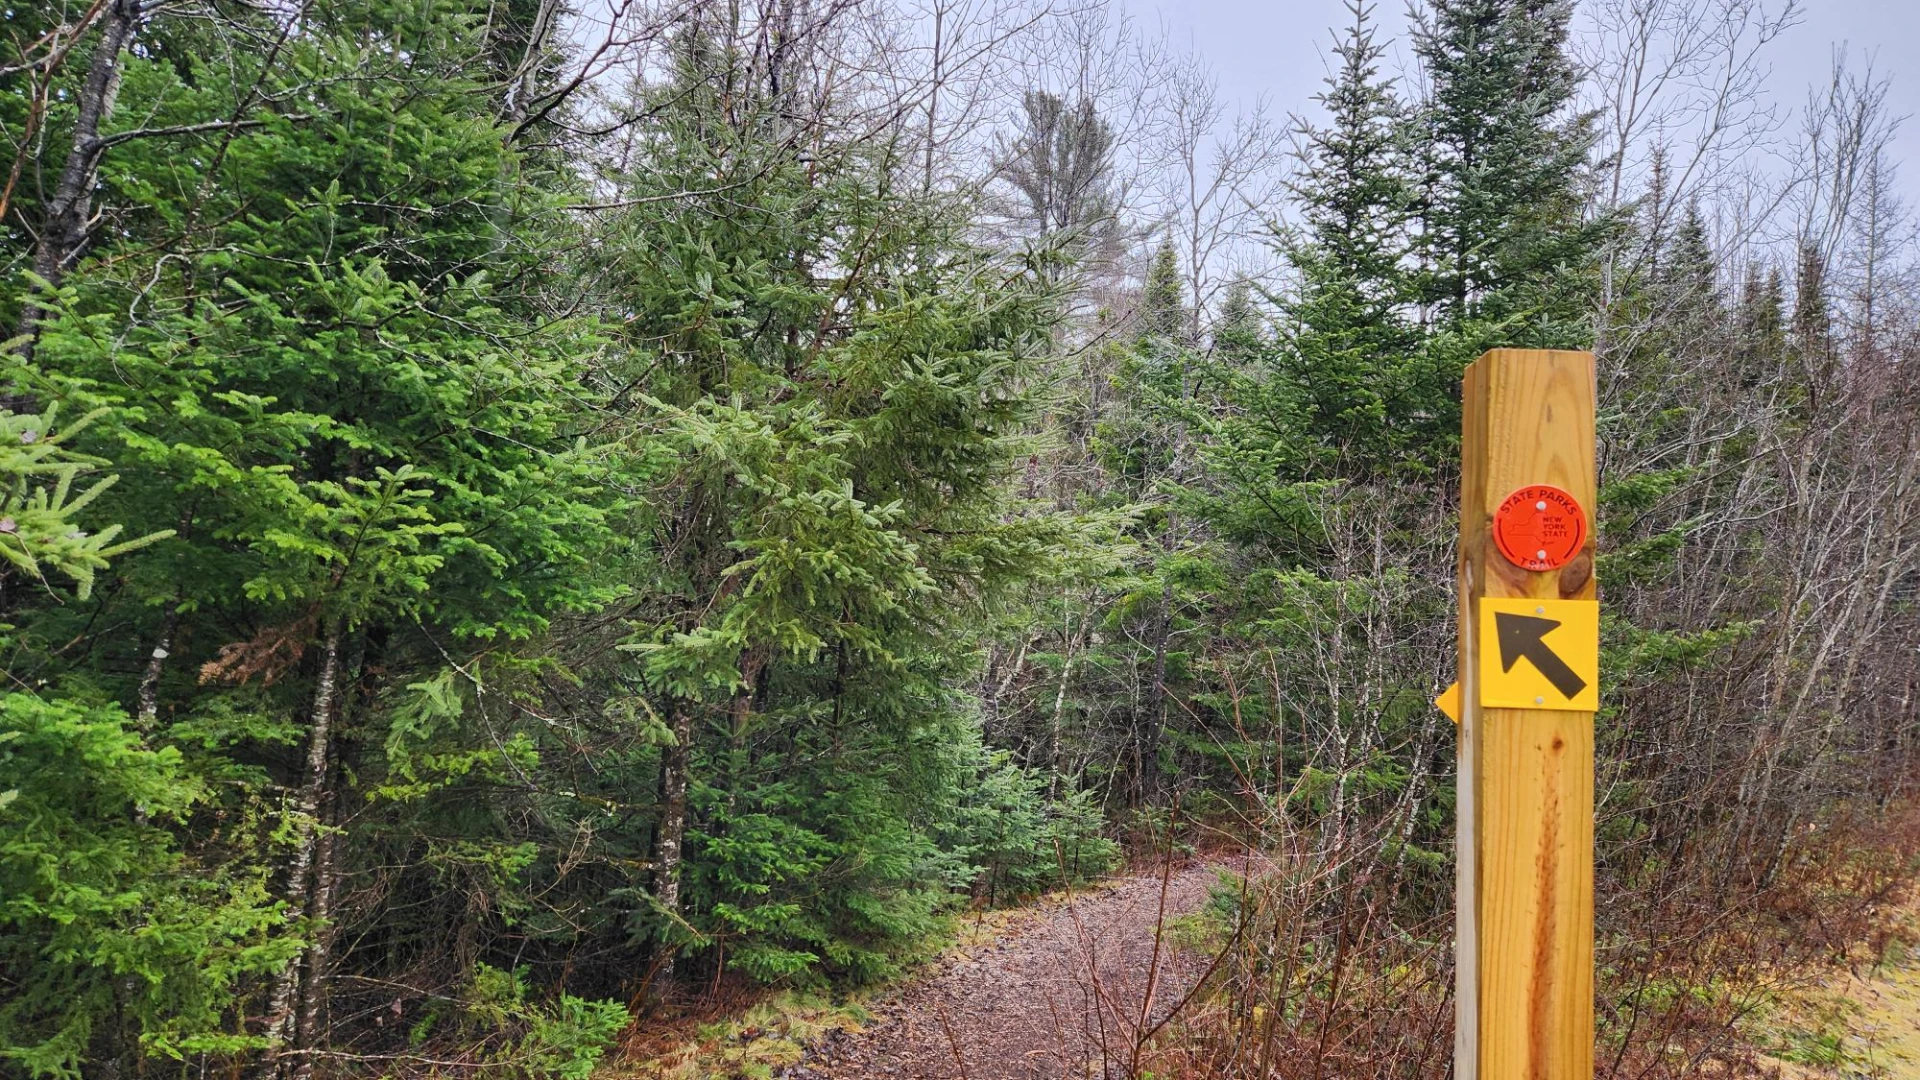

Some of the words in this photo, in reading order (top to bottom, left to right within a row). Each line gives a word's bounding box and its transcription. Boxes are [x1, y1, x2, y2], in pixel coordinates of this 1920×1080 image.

[1500, 490, 1534, 514] STATE
[1539, 489, 1577, 515] PARKS
[1520, 557, 1559, 569] TRAIL
